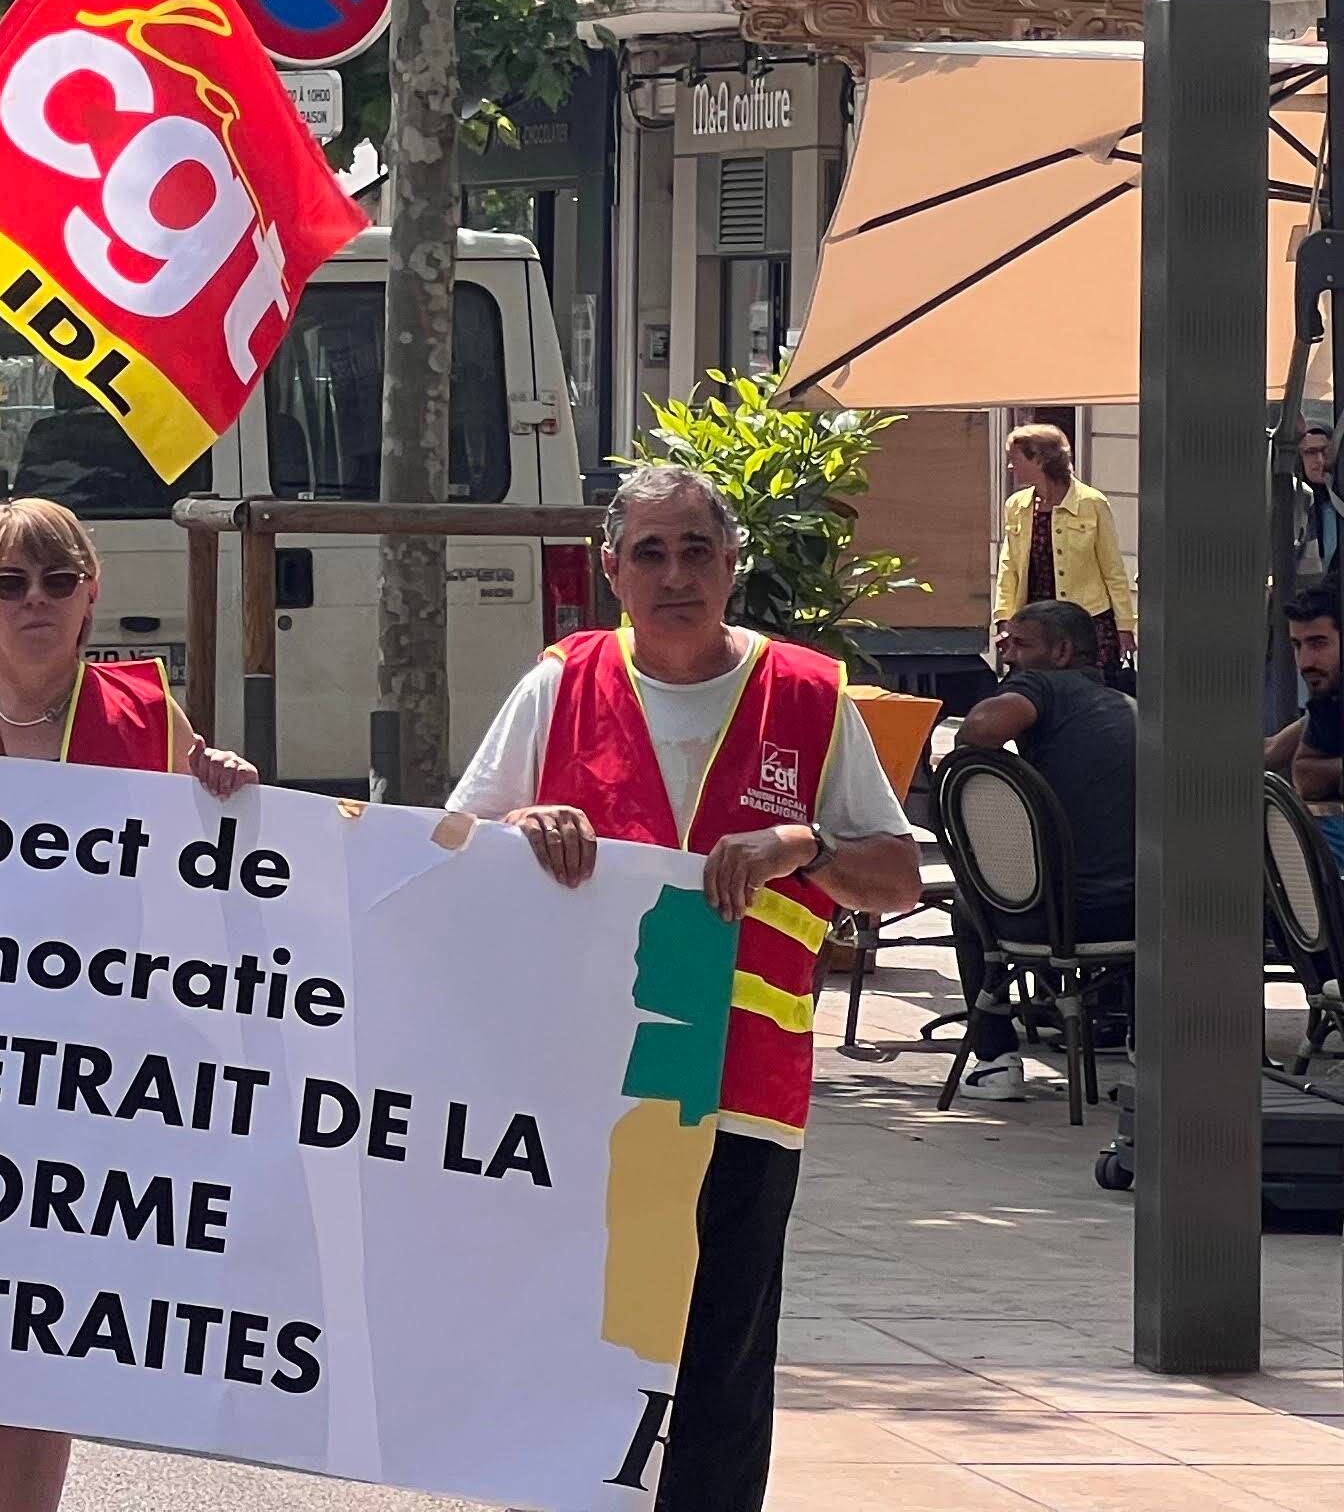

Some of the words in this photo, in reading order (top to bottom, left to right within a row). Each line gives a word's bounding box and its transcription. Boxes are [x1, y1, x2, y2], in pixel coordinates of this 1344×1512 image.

[693, 82, 728, 135] M&A
[733, 78, 792, 131] coiffure
[0, 29, 289, 385] cgt
[740, 794, 809, 824] DRAGUIGNA
[761, 764, 797, 791] cgt
[179, 817, 291, 899] de
[298, 1077, 413, 1162] DE
[443, 1101, 553, 1188] LA
